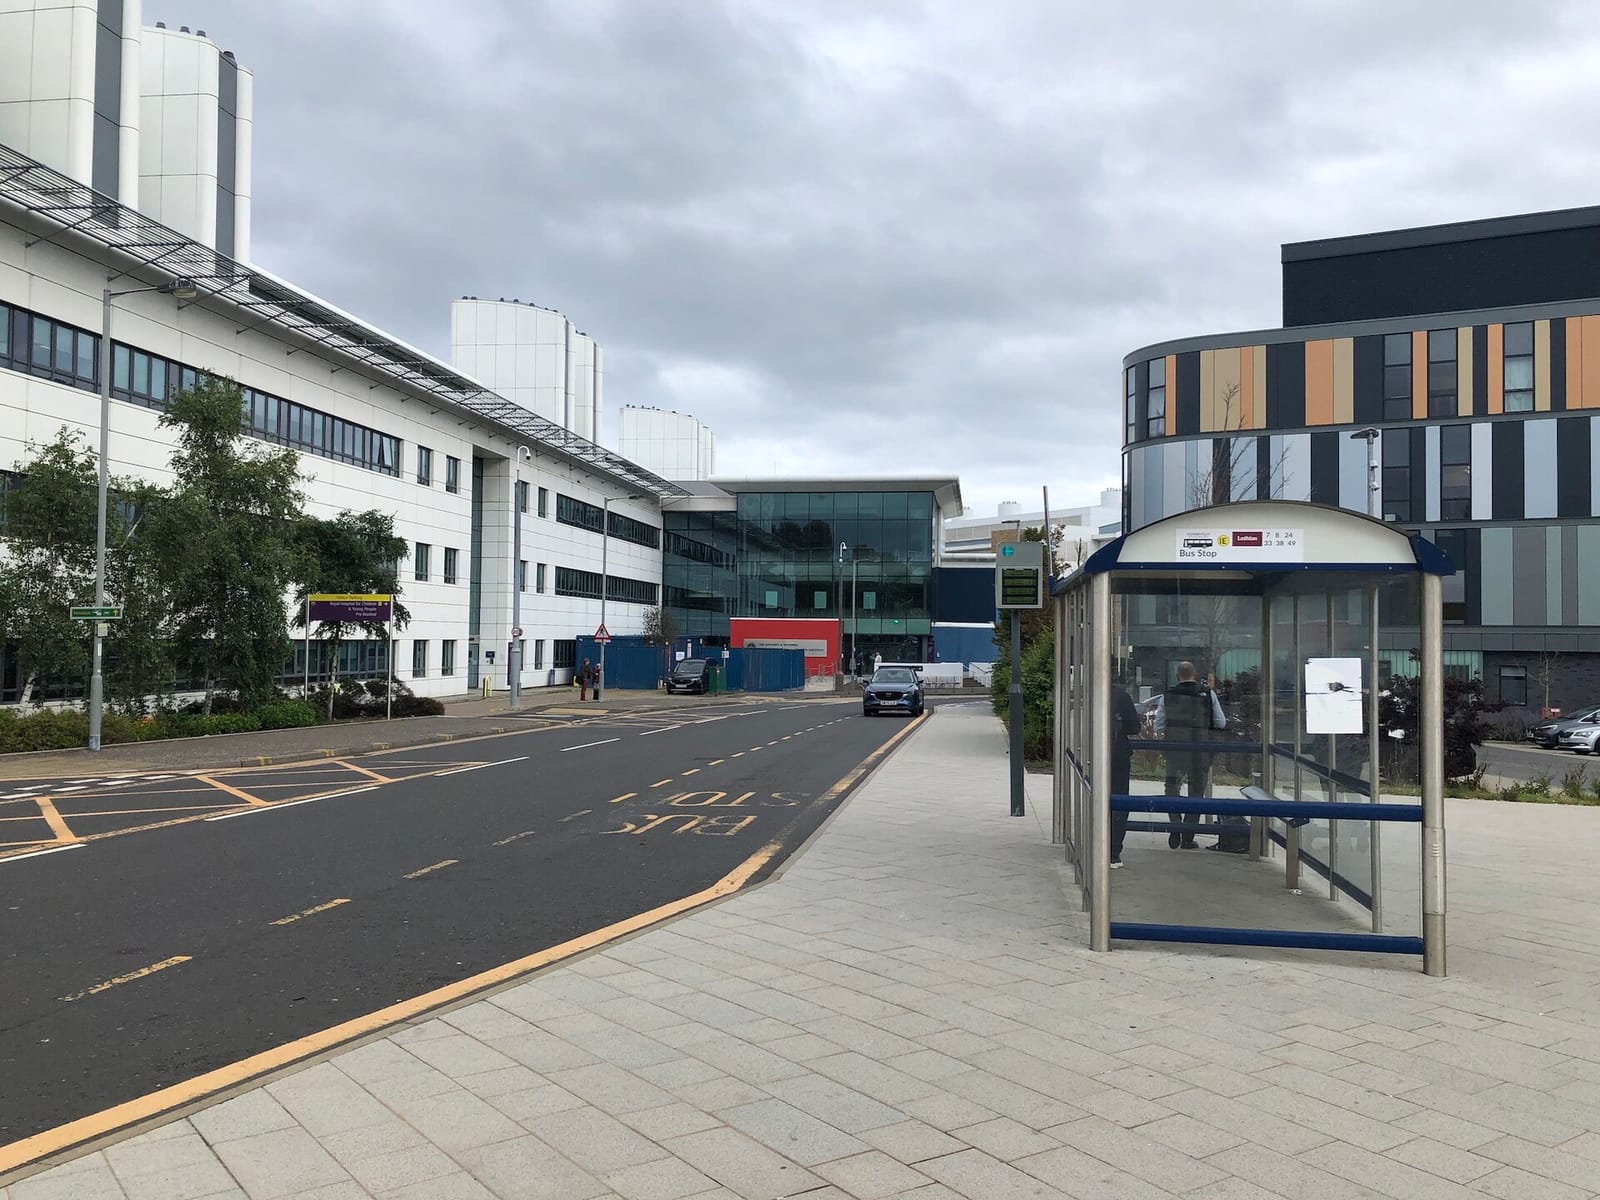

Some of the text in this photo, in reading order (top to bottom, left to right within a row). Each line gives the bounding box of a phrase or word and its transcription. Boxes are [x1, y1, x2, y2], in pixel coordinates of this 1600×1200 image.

[1179, 549, 1217, 558] Bus Stop
[599, 814, 757, 836] BUS
